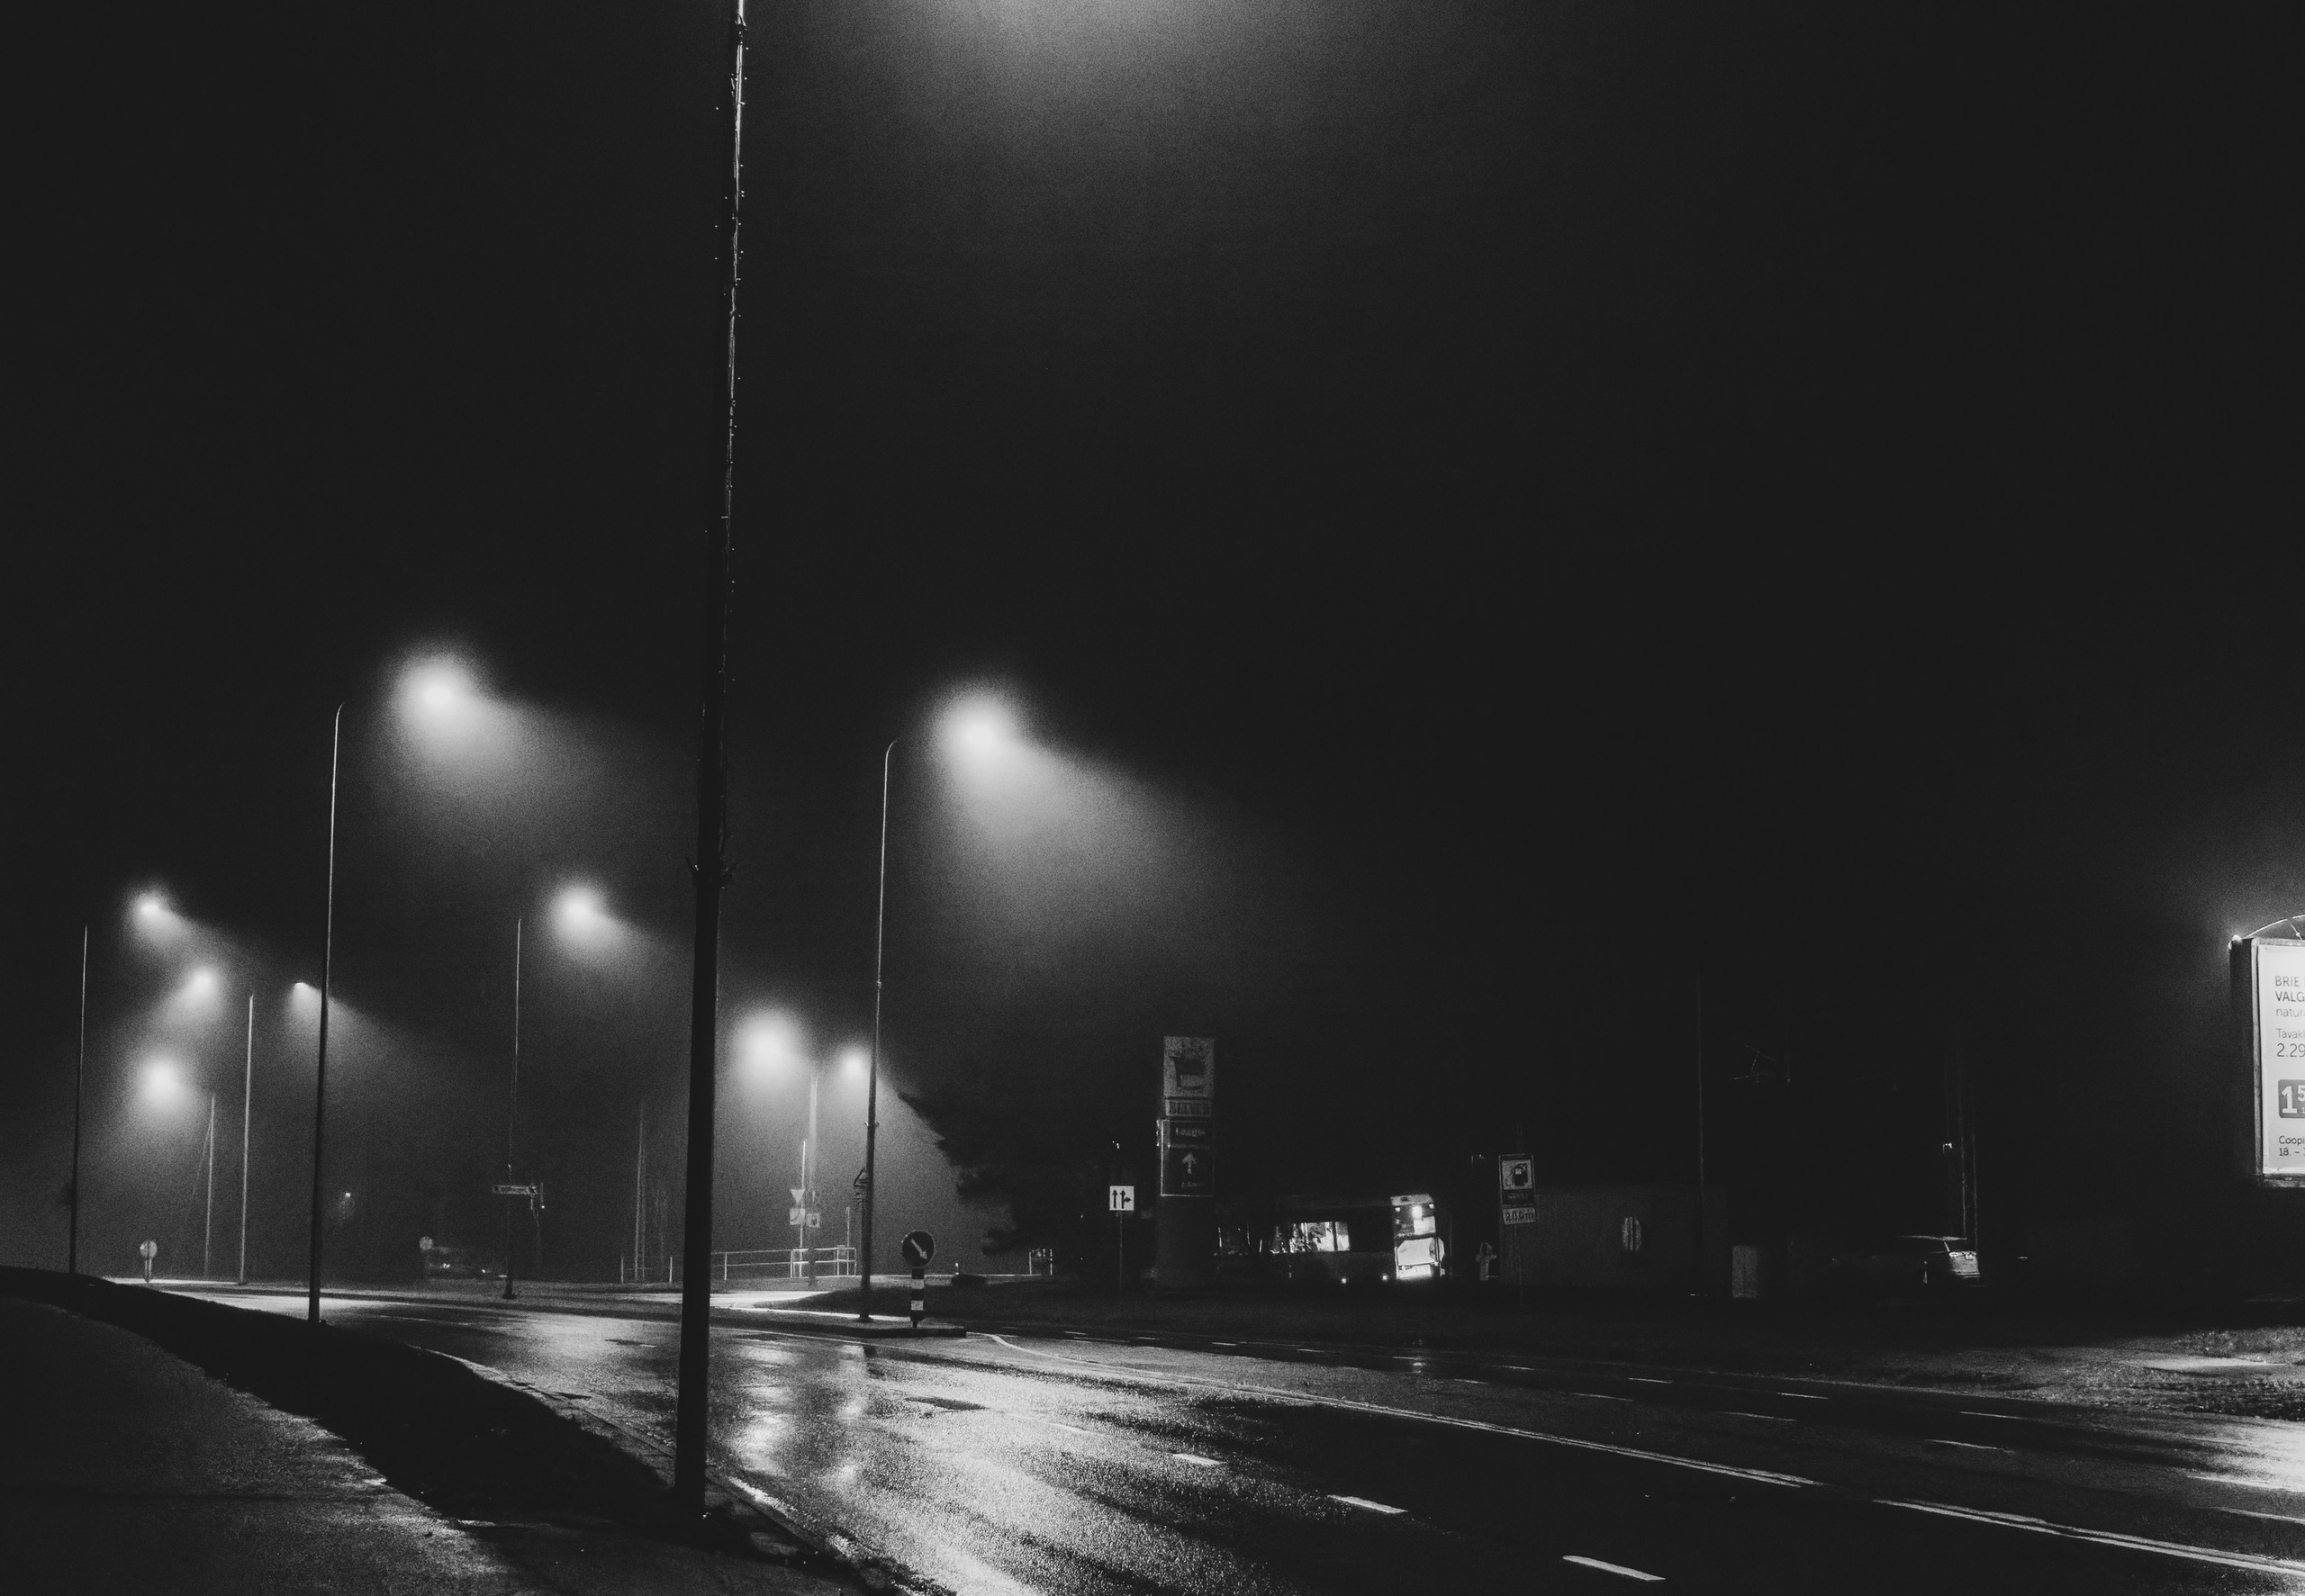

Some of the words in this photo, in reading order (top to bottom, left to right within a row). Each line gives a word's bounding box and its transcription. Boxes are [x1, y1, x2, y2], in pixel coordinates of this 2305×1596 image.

[2274, 976, 2300, 987] BRIE
[2274, 990, 2305, 1002] VALG
[2275, 1007, 2305, 1017] natur
[2276, 1042, 2305, 1058] 2.29
